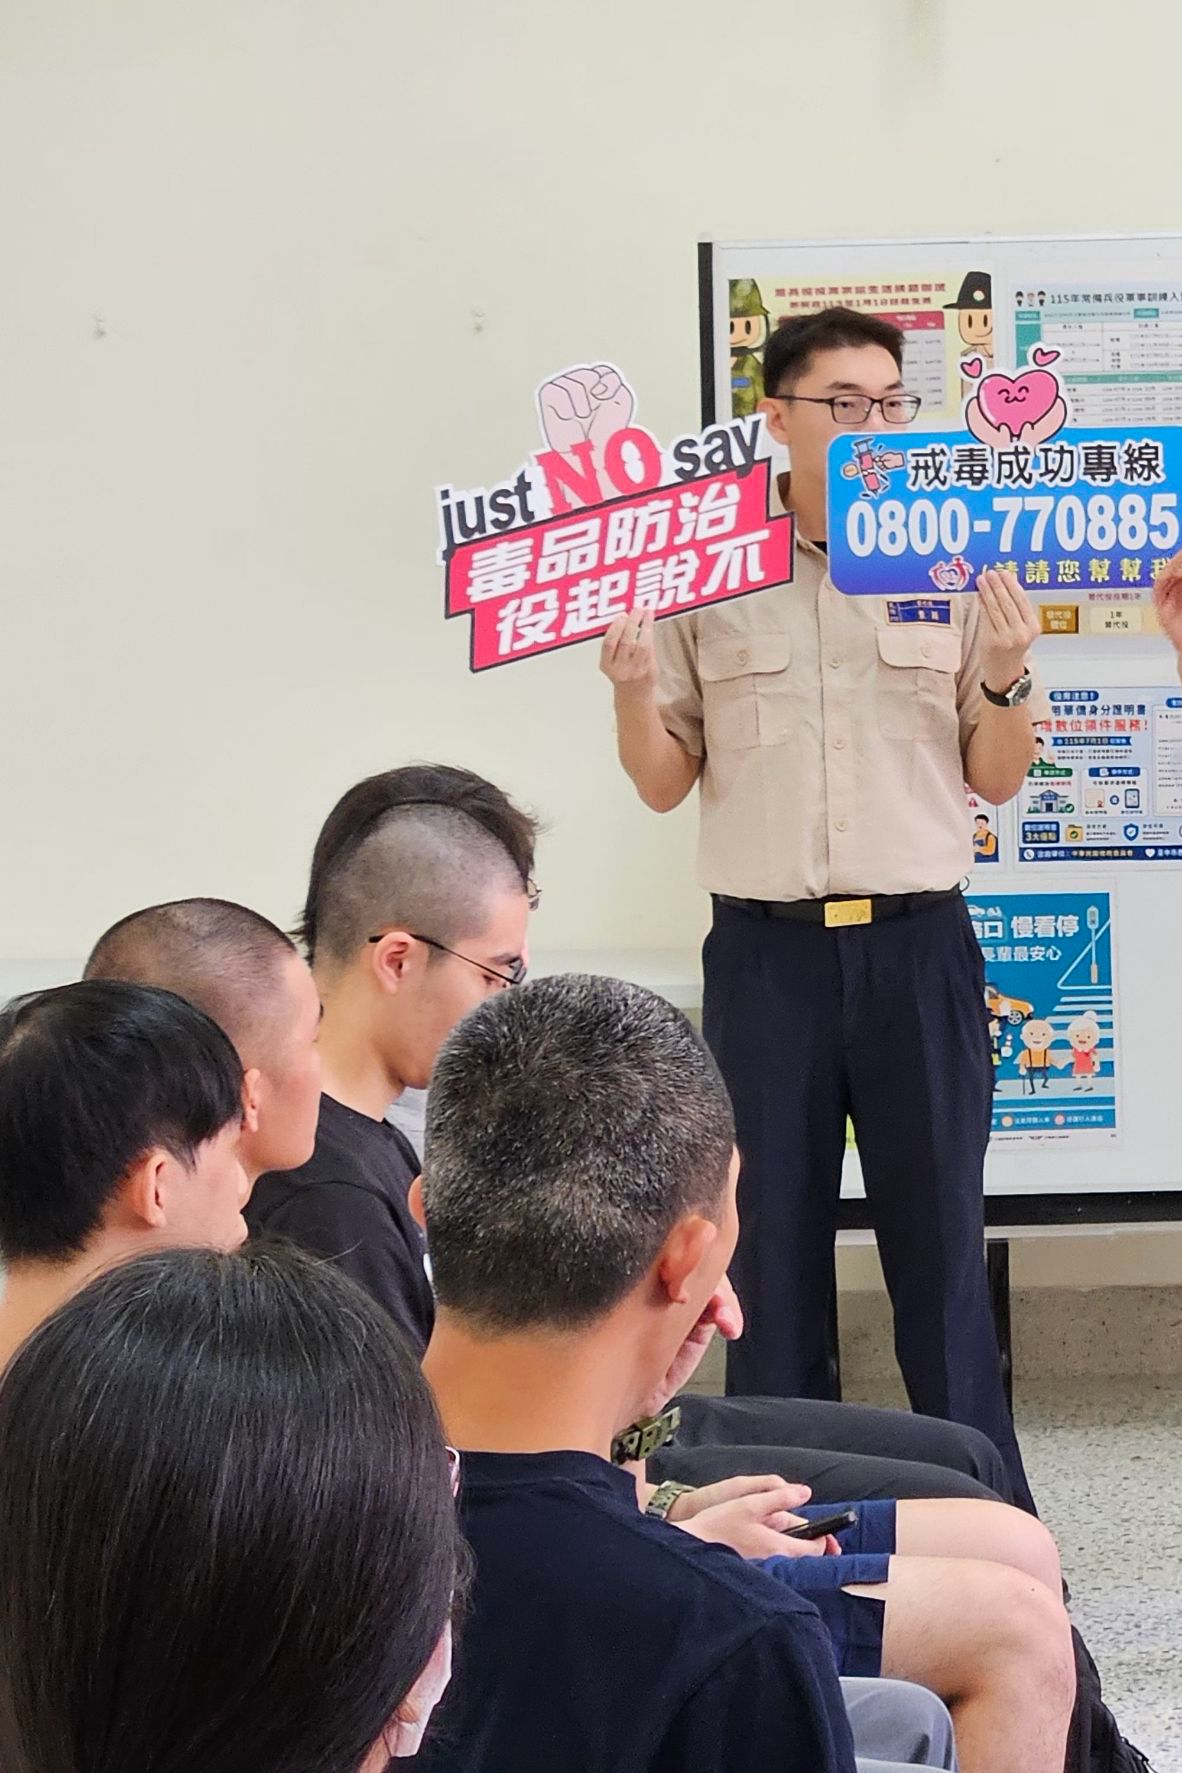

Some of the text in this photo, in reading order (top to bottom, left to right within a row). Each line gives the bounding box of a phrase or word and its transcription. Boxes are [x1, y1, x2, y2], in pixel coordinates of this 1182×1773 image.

[440, 418, 762, 560] just NO say
[910, 443, 1162, 488] 戒毒成功專線
[466, 482, 741, 602] 毒品防治
[846, 493, 1180, 557] 0800-770885
[496, 529, 770, 655] 役起說不
[1011, 915, 1080, 938] 慢看停
